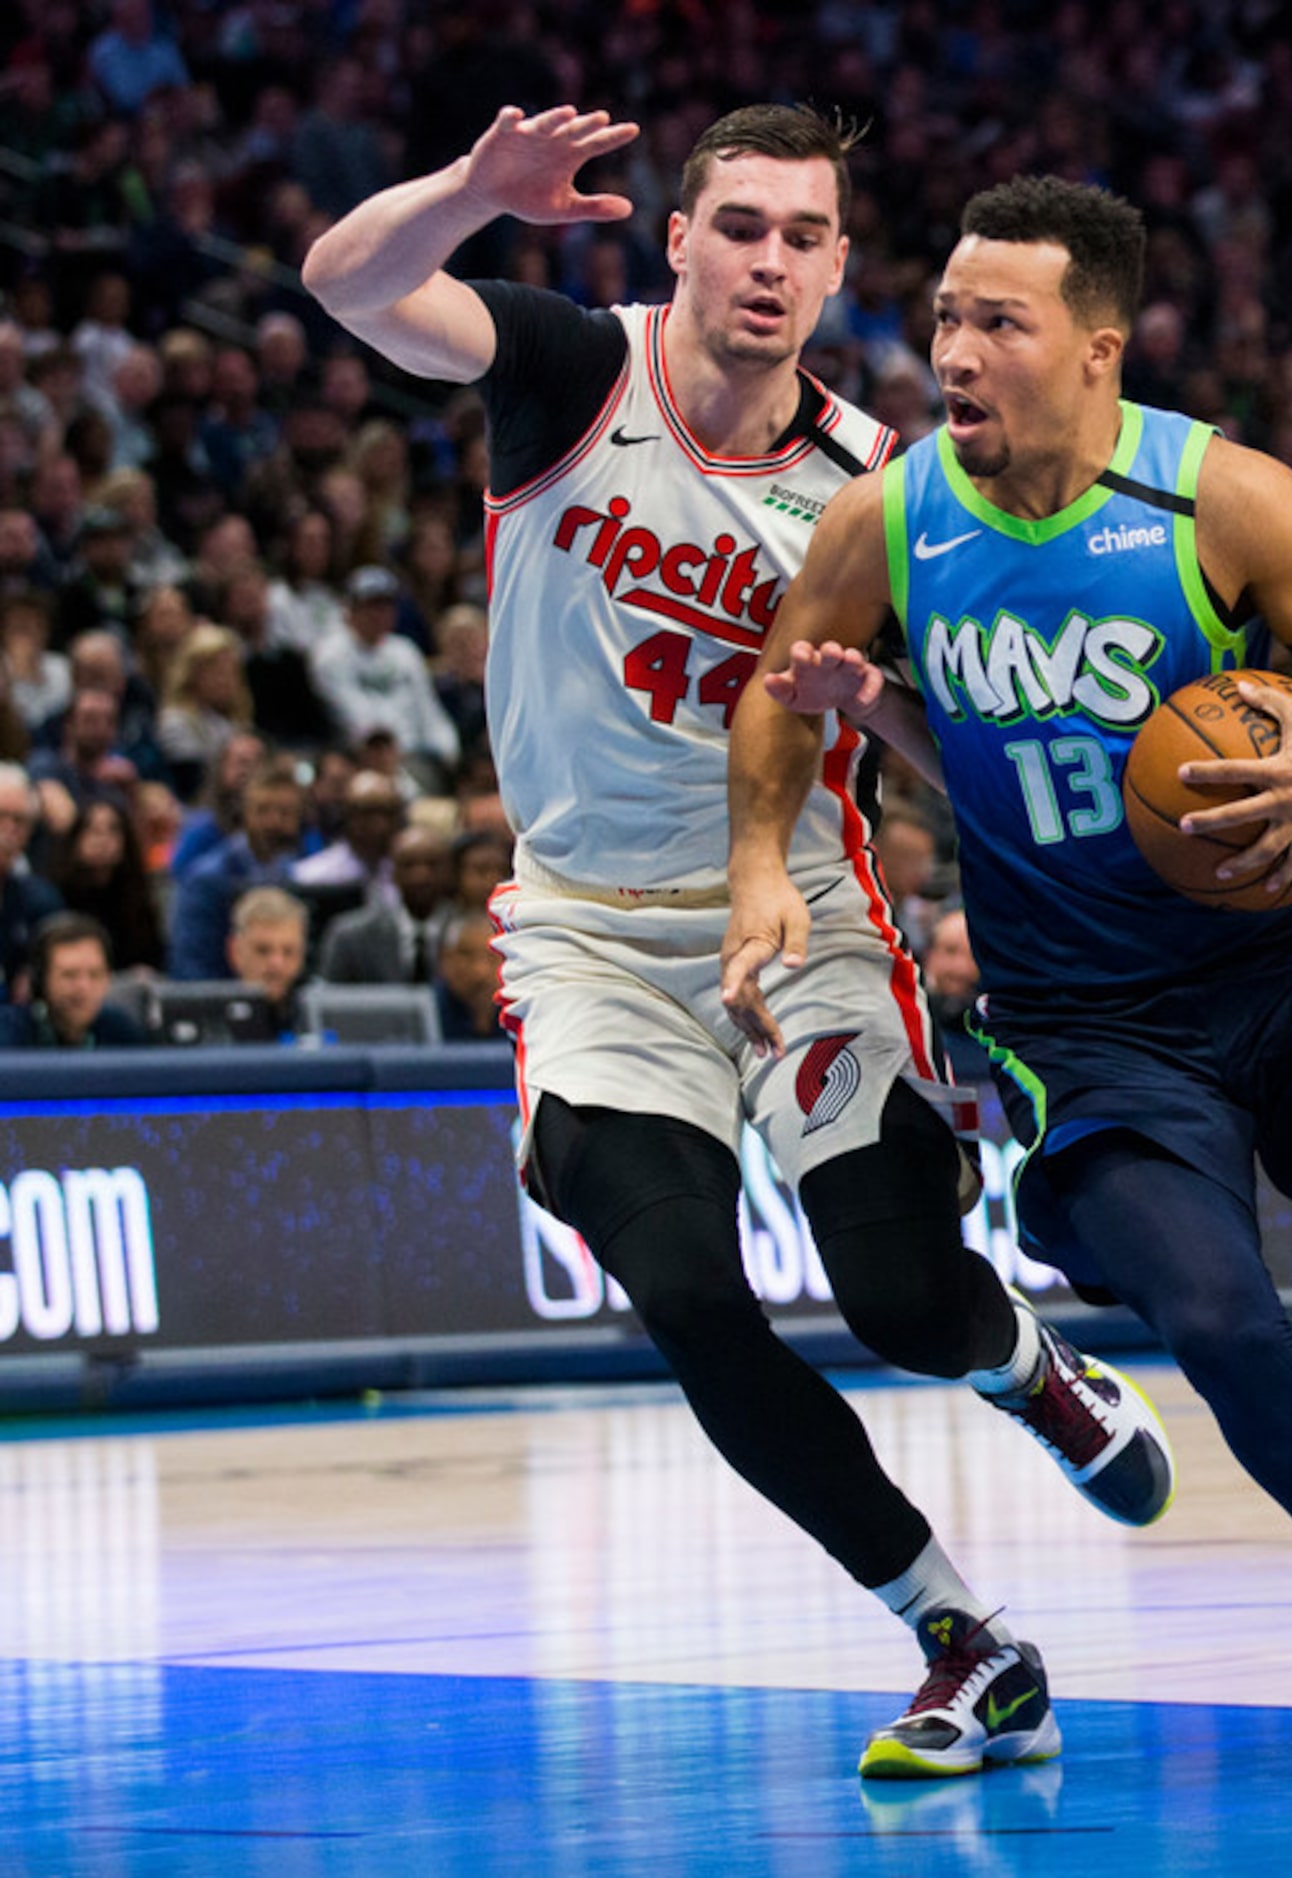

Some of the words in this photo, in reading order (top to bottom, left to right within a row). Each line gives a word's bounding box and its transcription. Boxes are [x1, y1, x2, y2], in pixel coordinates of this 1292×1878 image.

[1088, 523, 1167, 555] chime
[924, 609, 1164, 731] MAVS
[1004, 736, 1125, 846] 13
